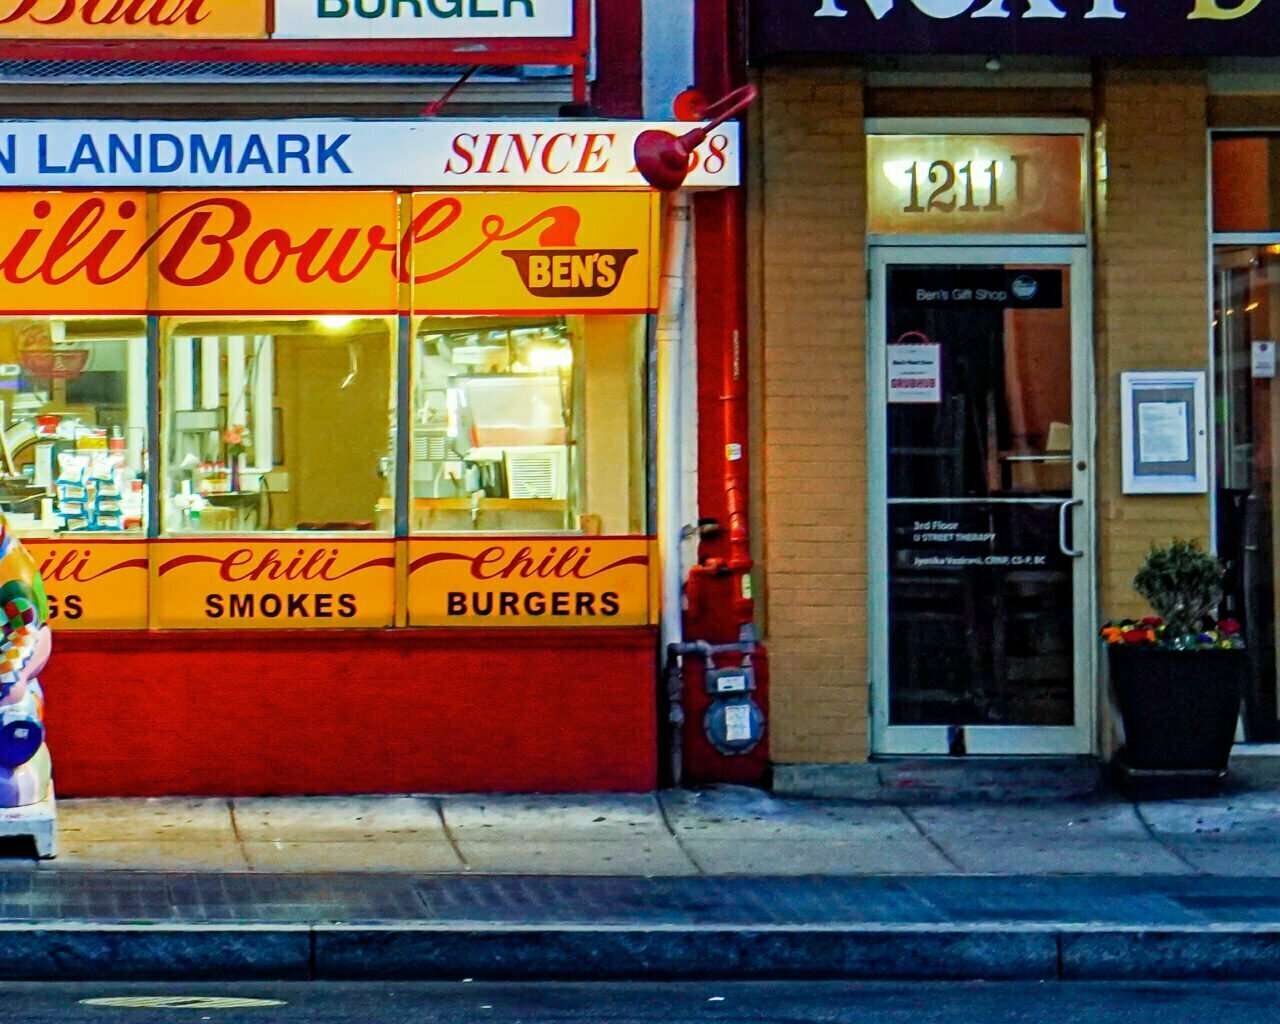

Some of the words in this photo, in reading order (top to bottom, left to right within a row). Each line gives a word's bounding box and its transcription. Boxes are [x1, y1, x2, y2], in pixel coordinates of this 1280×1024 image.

[37, 133, 353, 175] LANDMARK
[444, 131, 616, 175] SINCE
[157, 196, 462, 287] Bowl
[528, 253, 617, 288] BEN'S
[975, 289, 1008, 302] Shop
[40, 549, 98, 582] ili
[219, 548, 342, 582] Chili
[470, 546, 594, 580] Chili
[204, 592, 358, 618] SMOKES
[447, 591, 620, 616] BURGERS
